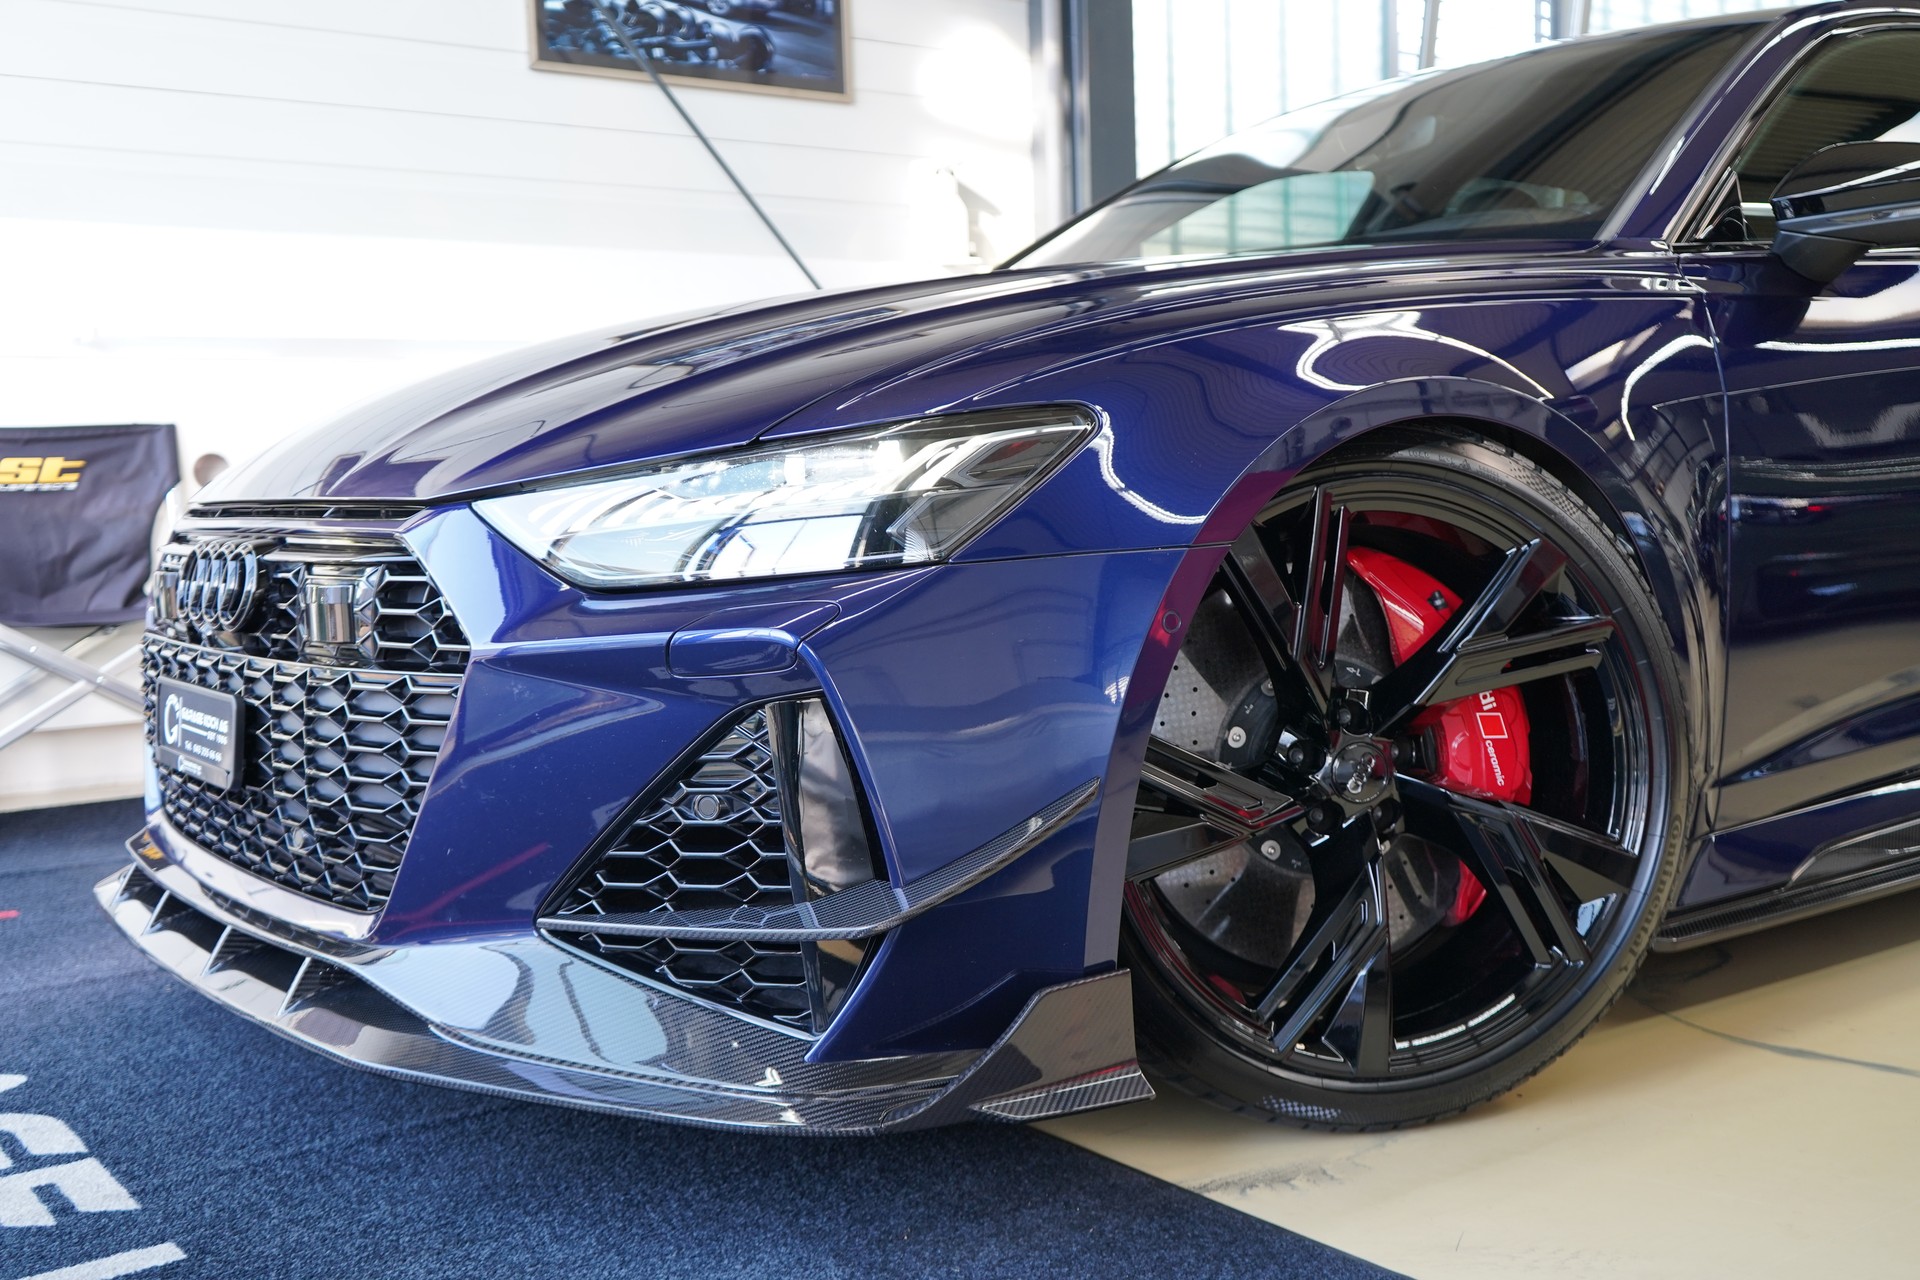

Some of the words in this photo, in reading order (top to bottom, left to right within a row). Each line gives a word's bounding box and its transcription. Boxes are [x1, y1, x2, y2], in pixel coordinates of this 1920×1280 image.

[1479, 690, 1497, 711] di
[1486, 740, 1505, 787] ceramic
[1629, 813, 1682, 960] Continental
